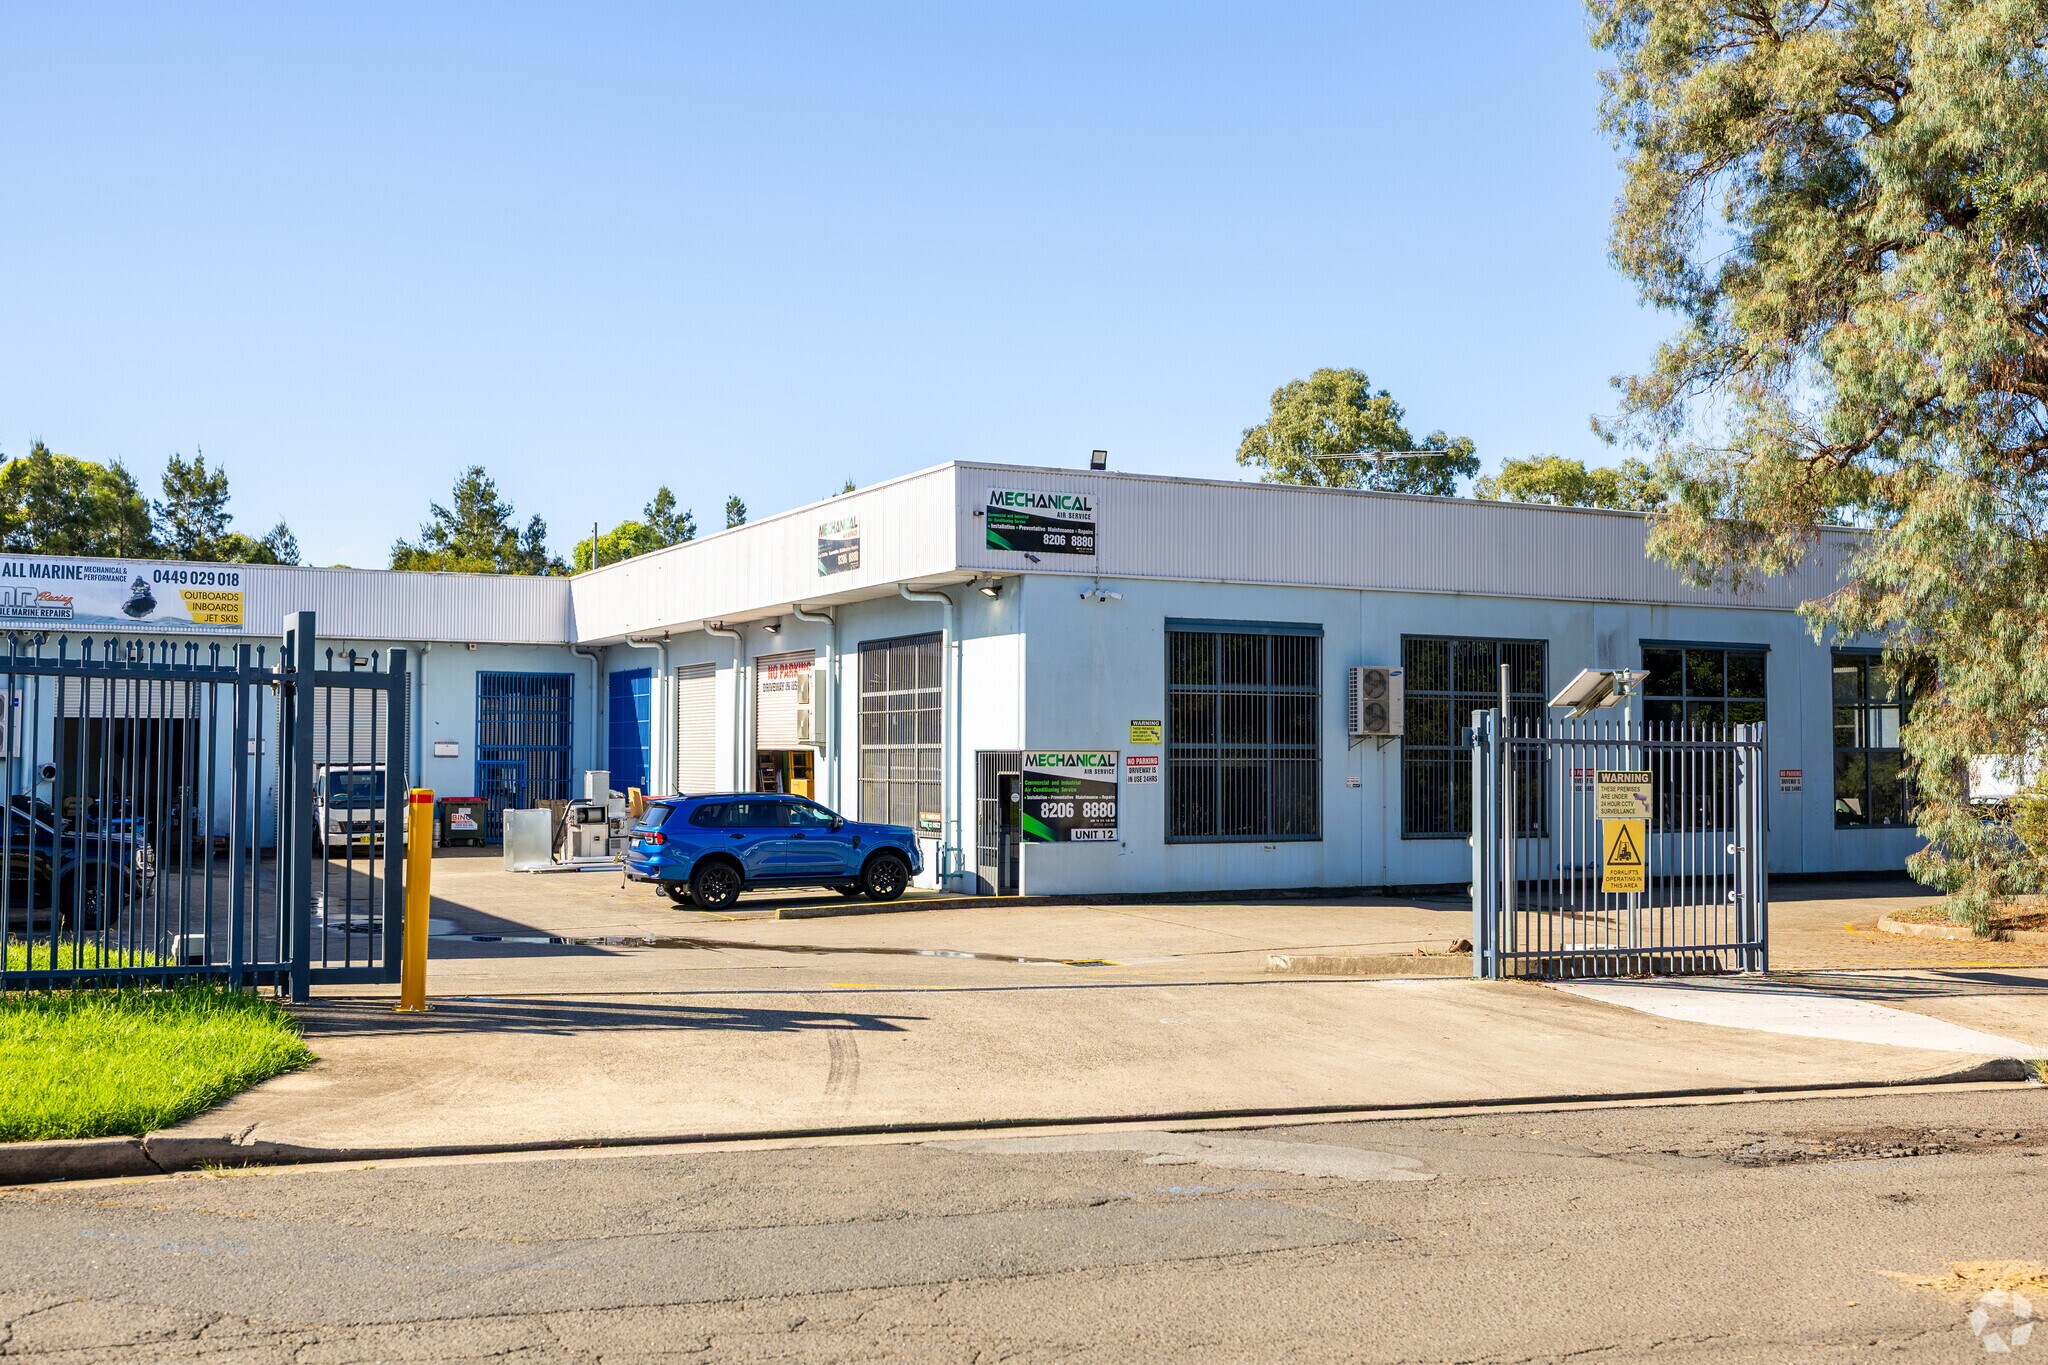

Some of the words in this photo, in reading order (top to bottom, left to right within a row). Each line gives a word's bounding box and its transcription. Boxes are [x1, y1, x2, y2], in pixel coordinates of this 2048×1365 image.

[990, 490, 1092, 511] MECHANICAL
[1069, 512, 1091, 520] SERVICE
[1043, 534, 1066, 545] 8206
[1071, 536, 1093, 547] 8880
[2, 562, 26, 578] ALL
[29, 563, 82, 580] MARINE
[84, 566, 122, 574] MECHANICAL
[84, 574, 127, 582] PERFORMANCE
[153, 569, 187, 585] 0449
[190, 571, 215, 586] 029
[217, 572, 239, 587] 018
[184, 591, 239, 601] OUTBOARDS
[11, 608, 39, 616] MARINE
[40, 609, 71, 617] REPAIRS
[192, 603, 239, 612] INBOARDS
[1025, 754, 1115, 767] MECHANICAL
[1136, 757, 1157, 765] PARKING
[1601, 773, 1649, 783] WARNING
[1041, 802, 1074, 818] 8206
[1082, 802, 1115, 818] 8880
[1075, 831, 1098, 839] UNIT
[1102, 830, 1113, 839] 12
